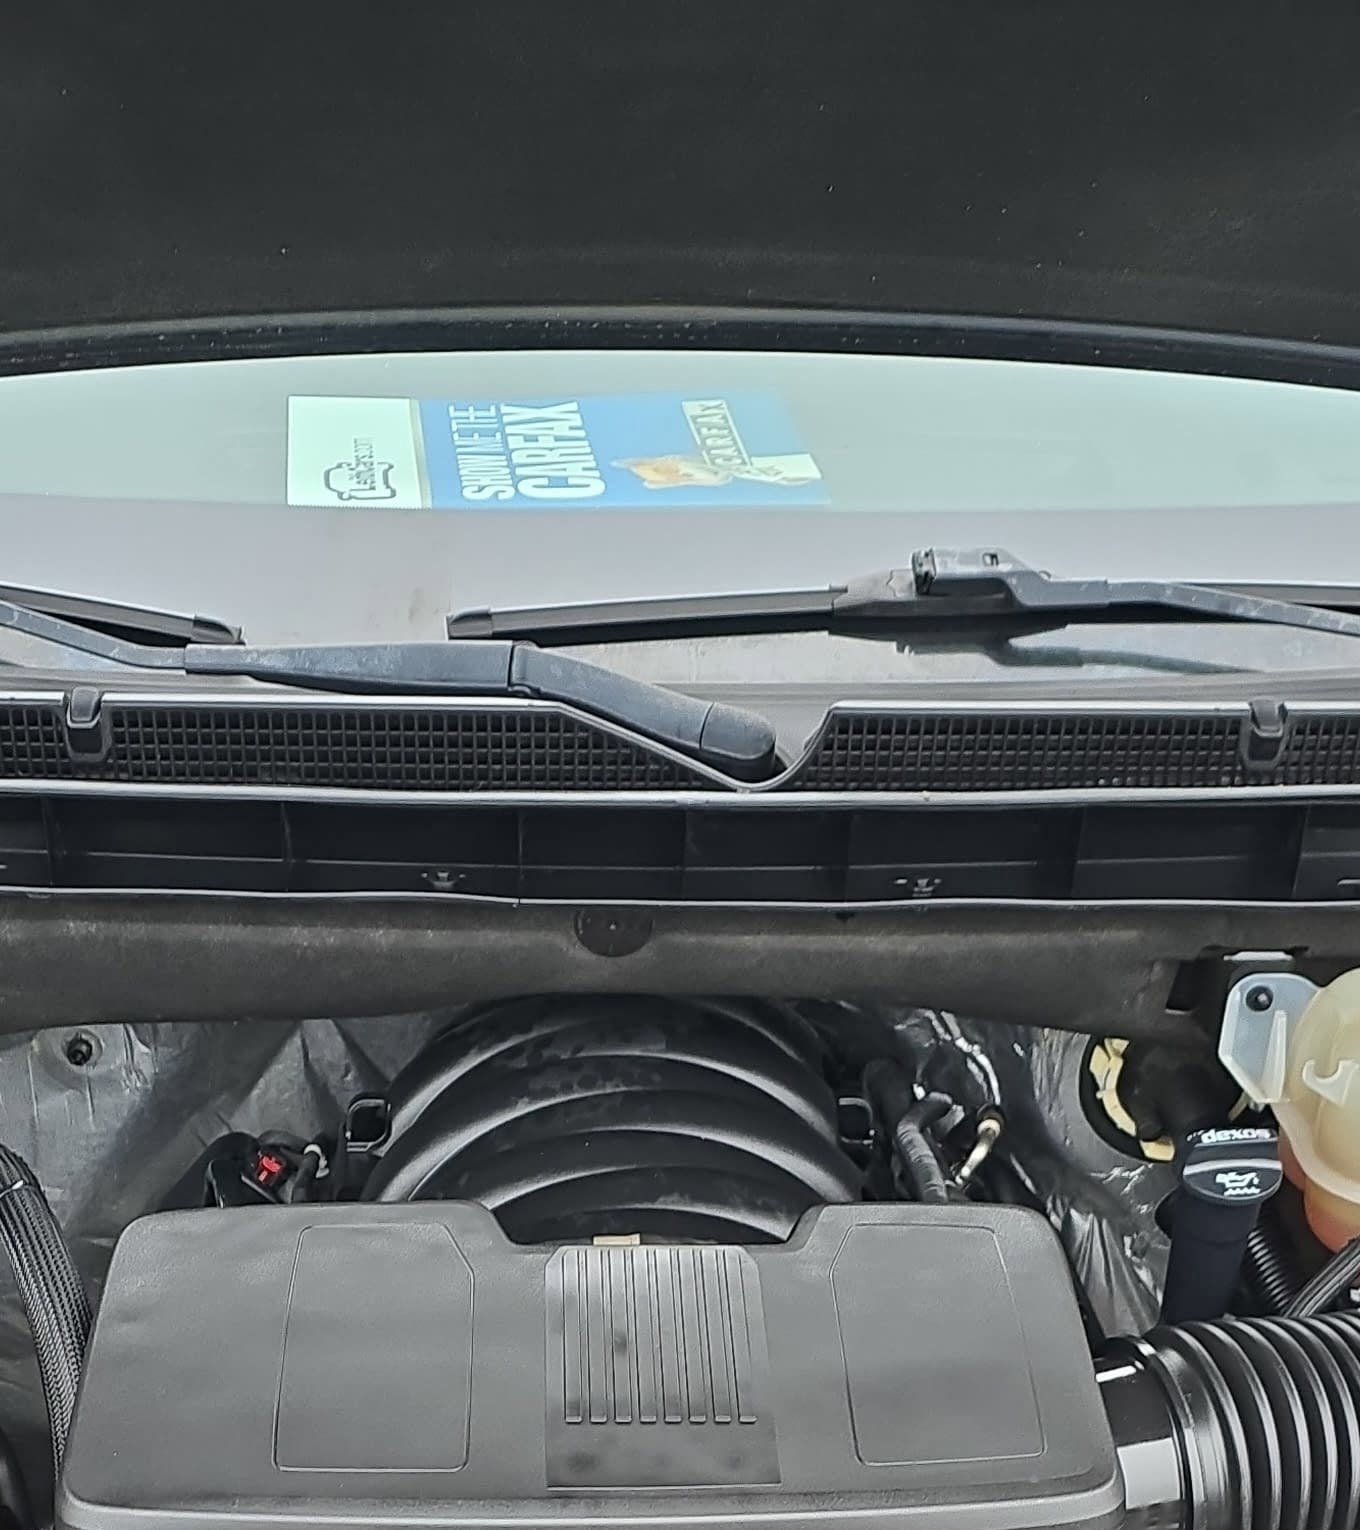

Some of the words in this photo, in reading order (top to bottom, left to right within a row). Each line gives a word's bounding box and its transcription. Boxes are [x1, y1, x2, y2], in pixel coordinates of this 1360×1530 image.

[448, 404, 499, 432] THE
[694, 401, 742, 466] CARFAX
[452, 431, 505, 454] ME
[500, 401, 607, 499] CARFAX
[456, 454, 516, 500] SHOW
